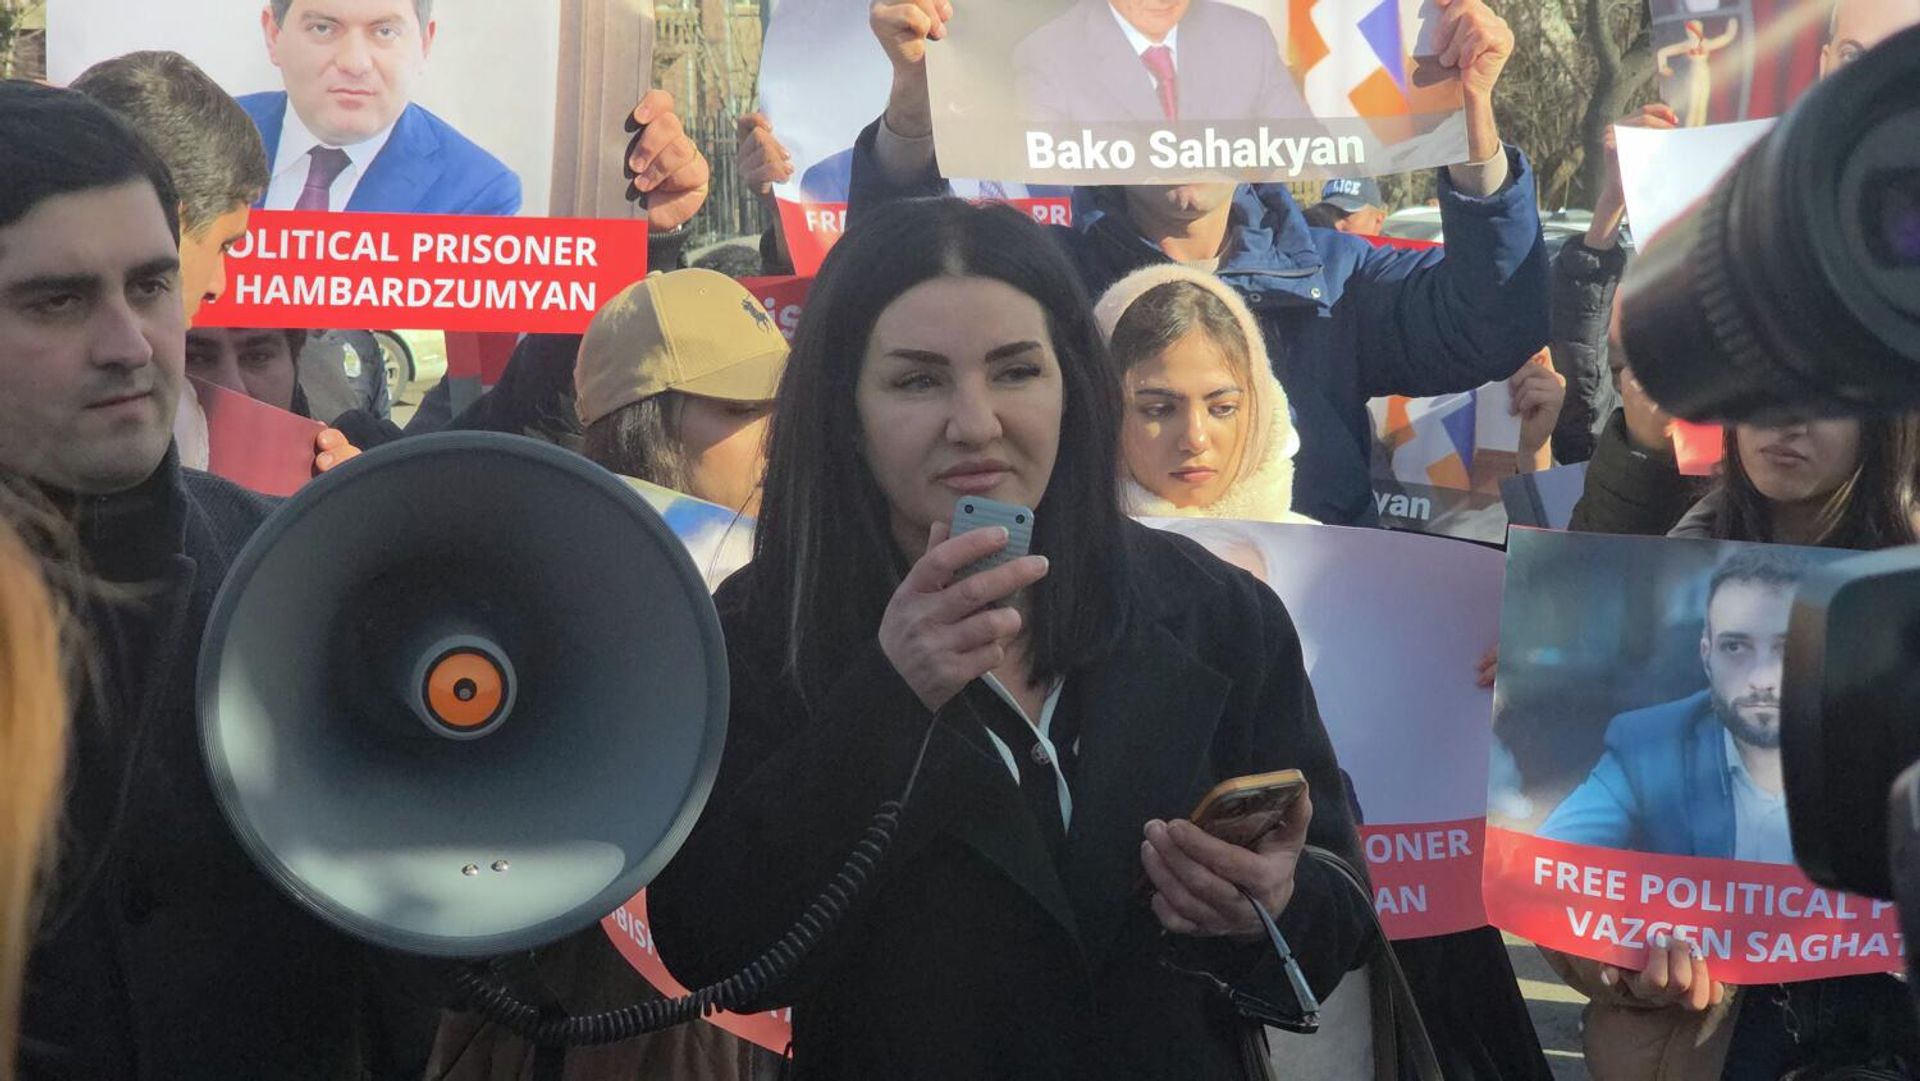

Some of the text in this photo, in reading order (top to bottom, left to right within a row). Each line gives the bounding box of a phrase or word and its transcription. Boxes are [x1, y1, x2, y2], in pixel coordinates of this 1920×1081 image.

[1025, 127, 1366, 176] Bako Sahakyan
[1332, 178, 1362, 196] LICE
[226, 228, 599, 267] OLITICAL PRISONER
[235, 274, 596, 312] HAMBARDZUMYAN
[1371, 488, 1431, 521] yan
[1364, 828, 1473, 864] ONER
[1374, 884, 1428, 915] AN
[1533, 856, 1628, 901] FREE
[1639, 873, 1858, 920] POLITICAL
[1745, 931, 1906, 964] SAGHAT
